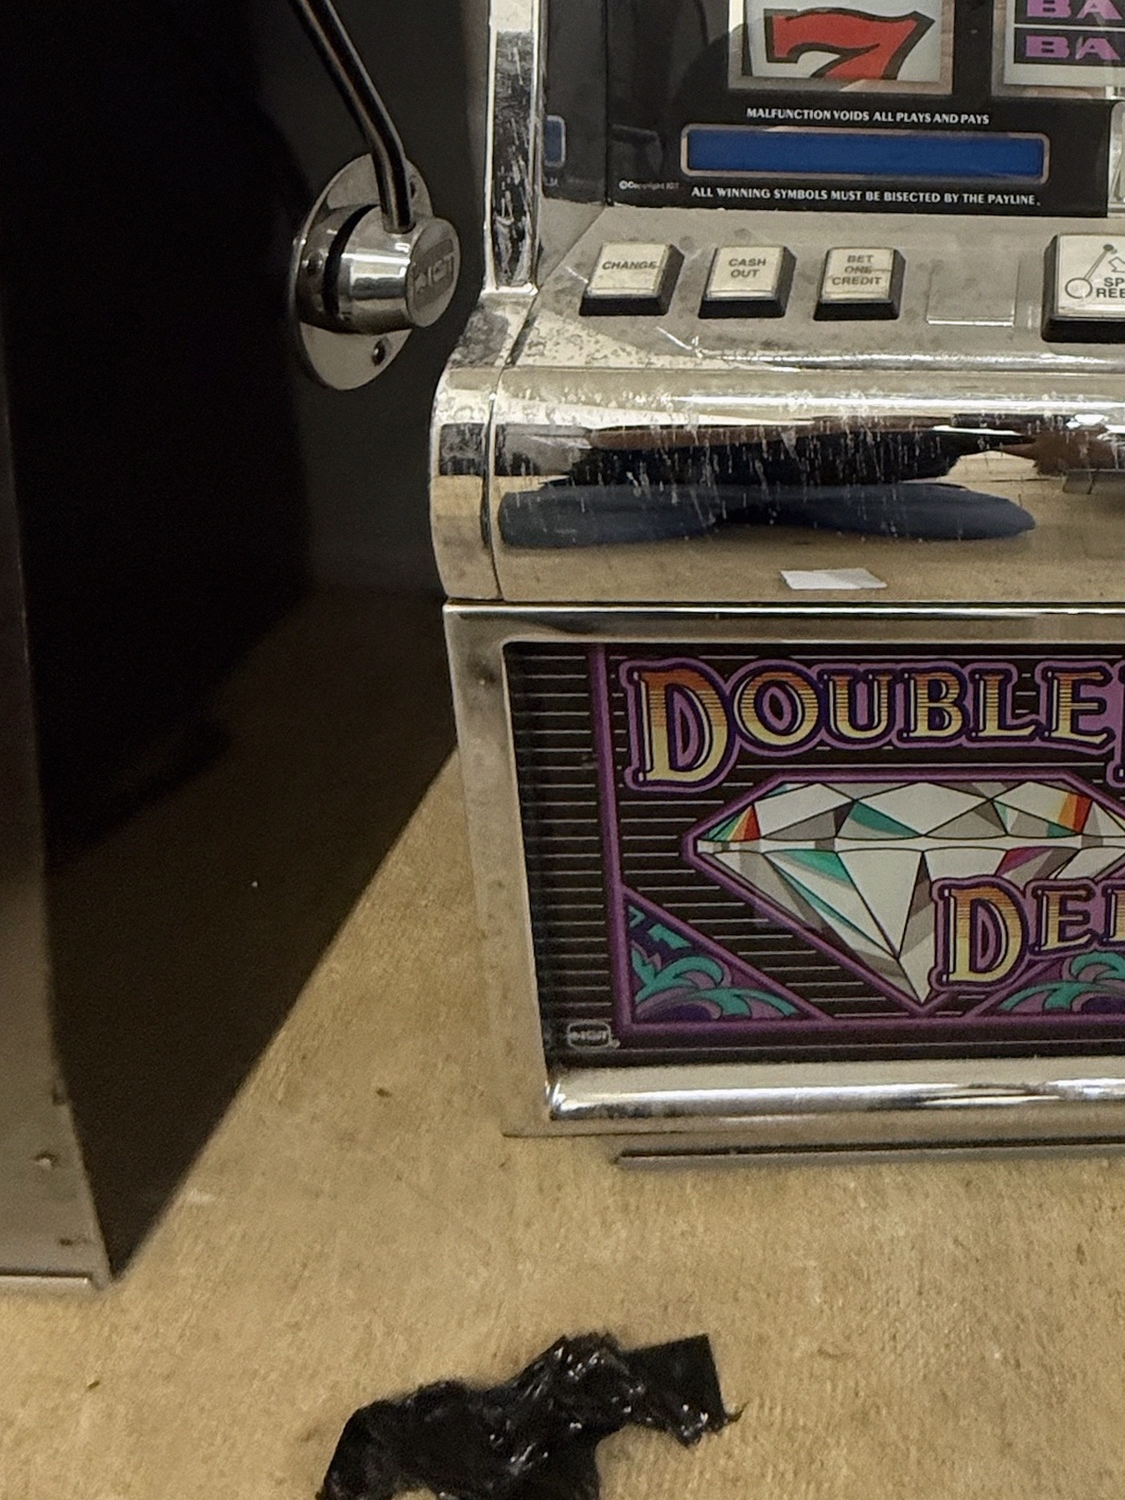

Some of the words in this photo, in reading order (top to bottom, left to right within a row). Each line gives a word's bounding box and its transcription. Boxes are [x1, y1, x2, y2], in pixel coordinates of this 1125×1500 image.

[746, 107, 831, 120] MALFUNCTION
[833, 110, 870, 121] VOIDS
[872, 111, 894, 122] ALL
[896, 112, 931, 123] PLAYS
[933, 113, 959, 124] AND
[960, 114, 990, 125] PAYS
[691, 186, 713, 198] ALL
[716, 187, 771, 199] WINNING
[774, 188, 828, 200] SYMBOLS
[831, 190, 862, 201] MUST
[865, 191, 881, 201] BE
[884, 191, 941, 203] BISECTED
[944, 193, 959, 203] BY
[962, 193, 985, 204] THE
[987, 194, 1041, 206] PAYLINE.
[602, 260, 658, 270] CHANGE
[728, 257, 767, 268] CASH
[846, 255, 874, 264] BET
[730, 268, 761, 278] OUT
[844, 265, 873, 275] ONE
[831, 275, 882, 286] CREDIT
[629, 663, 1116, 785] DOUBLE
